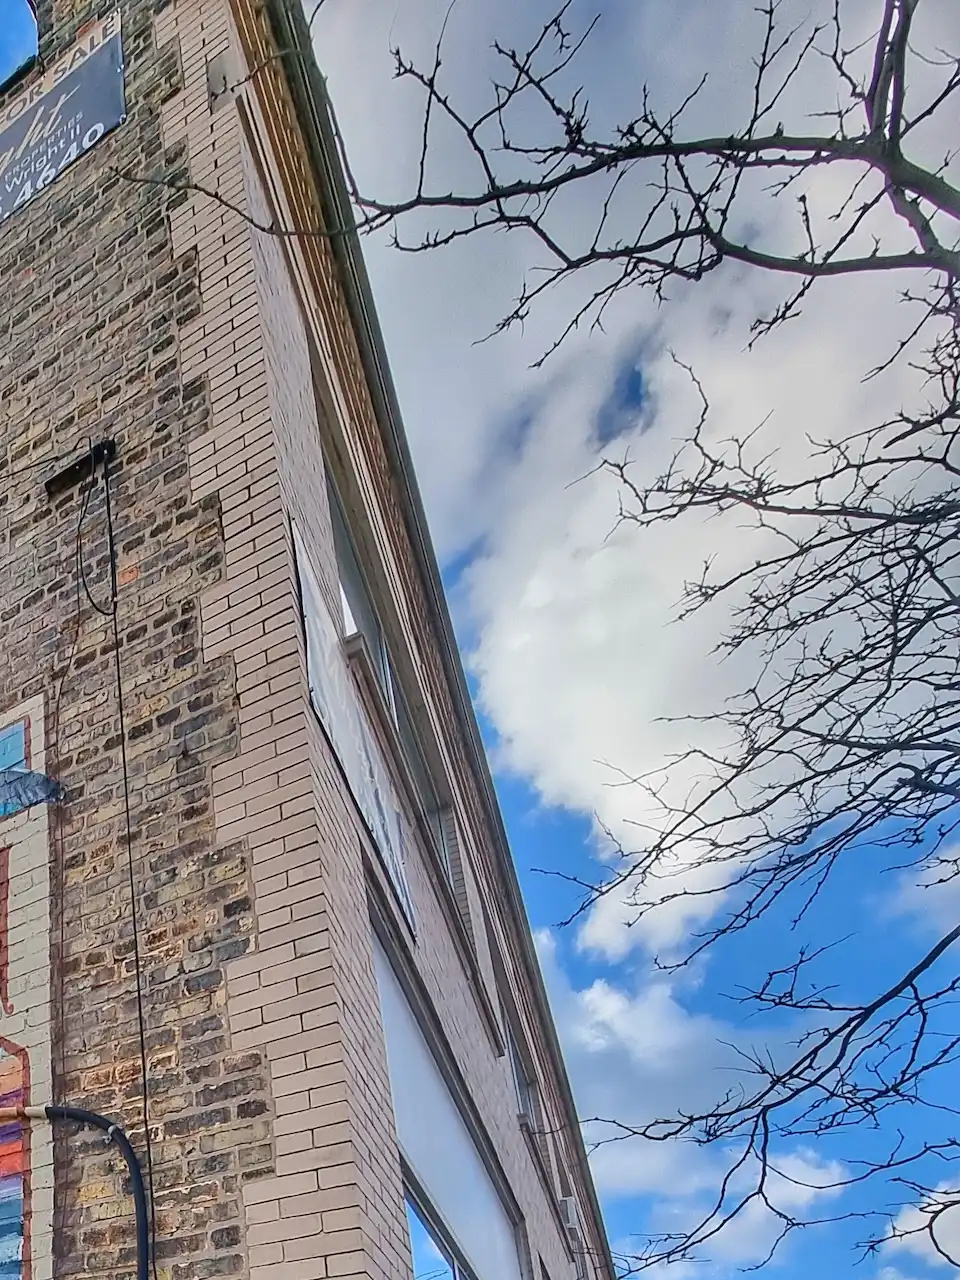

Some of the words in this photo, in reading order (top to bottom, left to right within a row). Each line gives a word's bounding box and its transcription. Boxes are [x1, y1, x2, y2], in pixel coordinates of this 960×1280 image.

[52, 19, 116, 84] SALE
[4, 111, 84, 182] PROPERTIES
[4, 139, 66, 193] Wright
